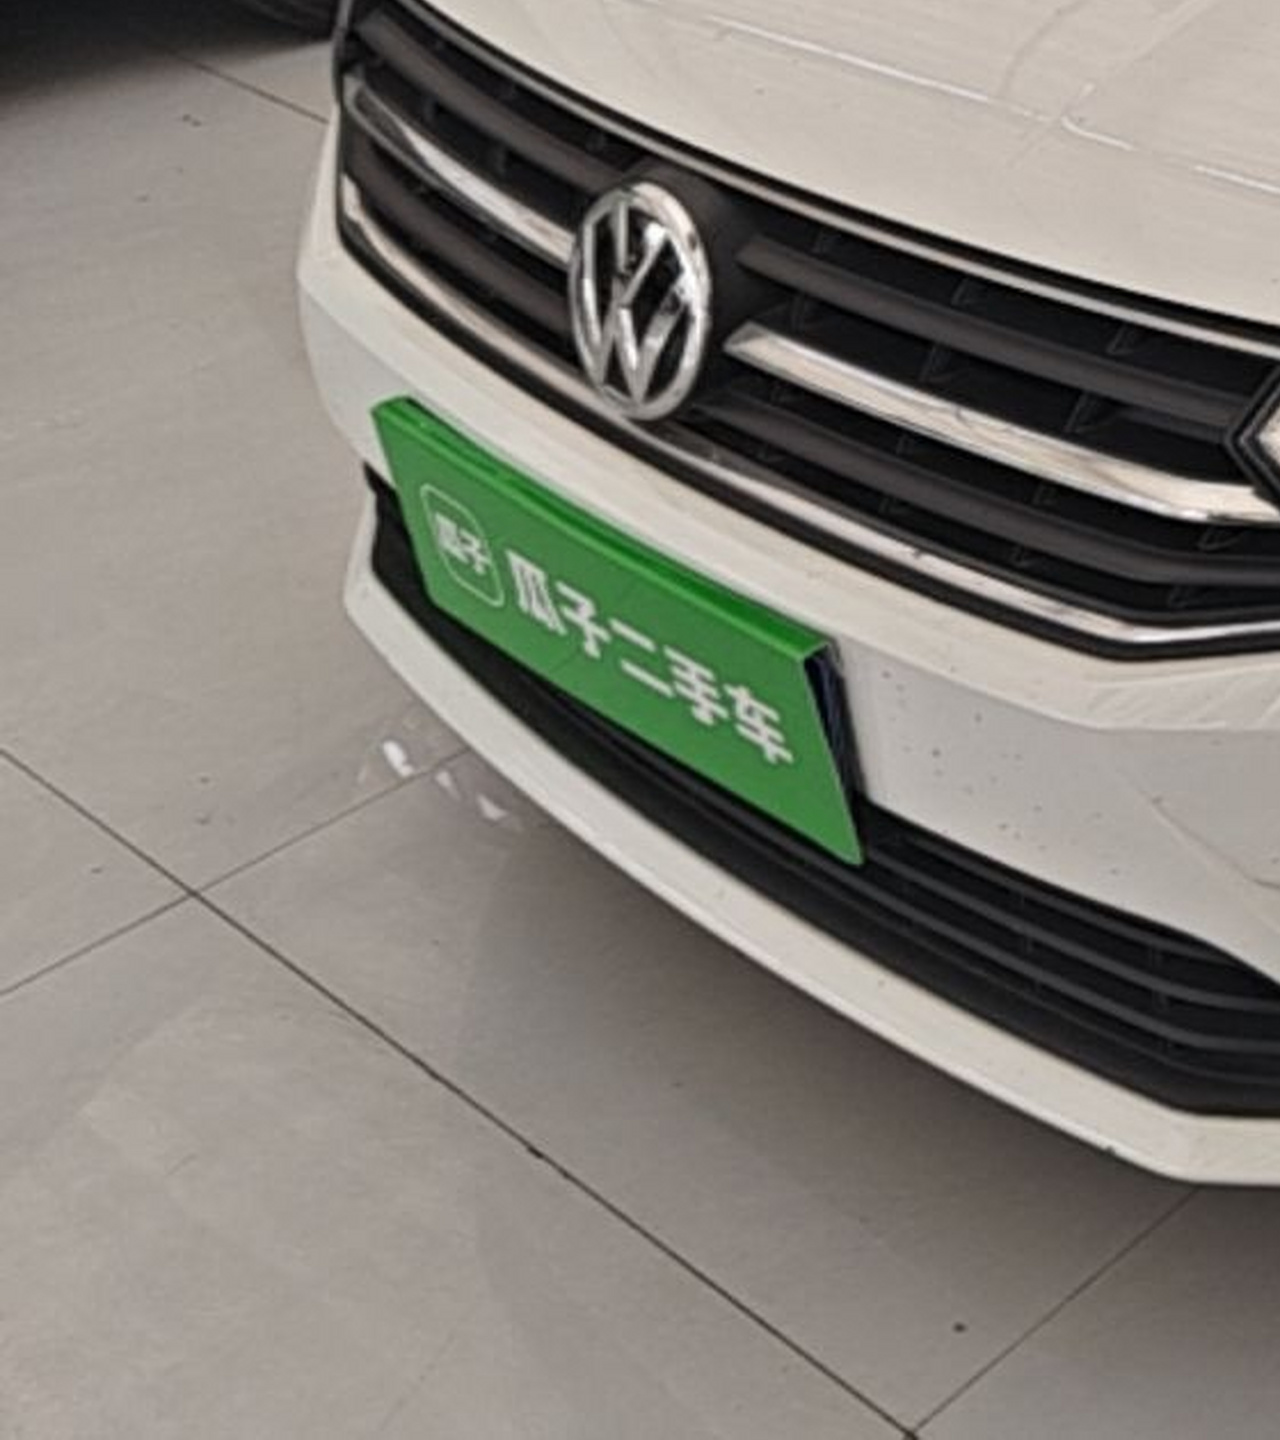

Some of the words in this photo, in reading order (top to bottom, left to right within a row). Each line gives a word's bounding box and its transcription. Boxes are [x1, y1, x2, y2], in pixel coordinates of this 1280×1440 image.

[506, 548, 794, 766] 瓜子二手车
